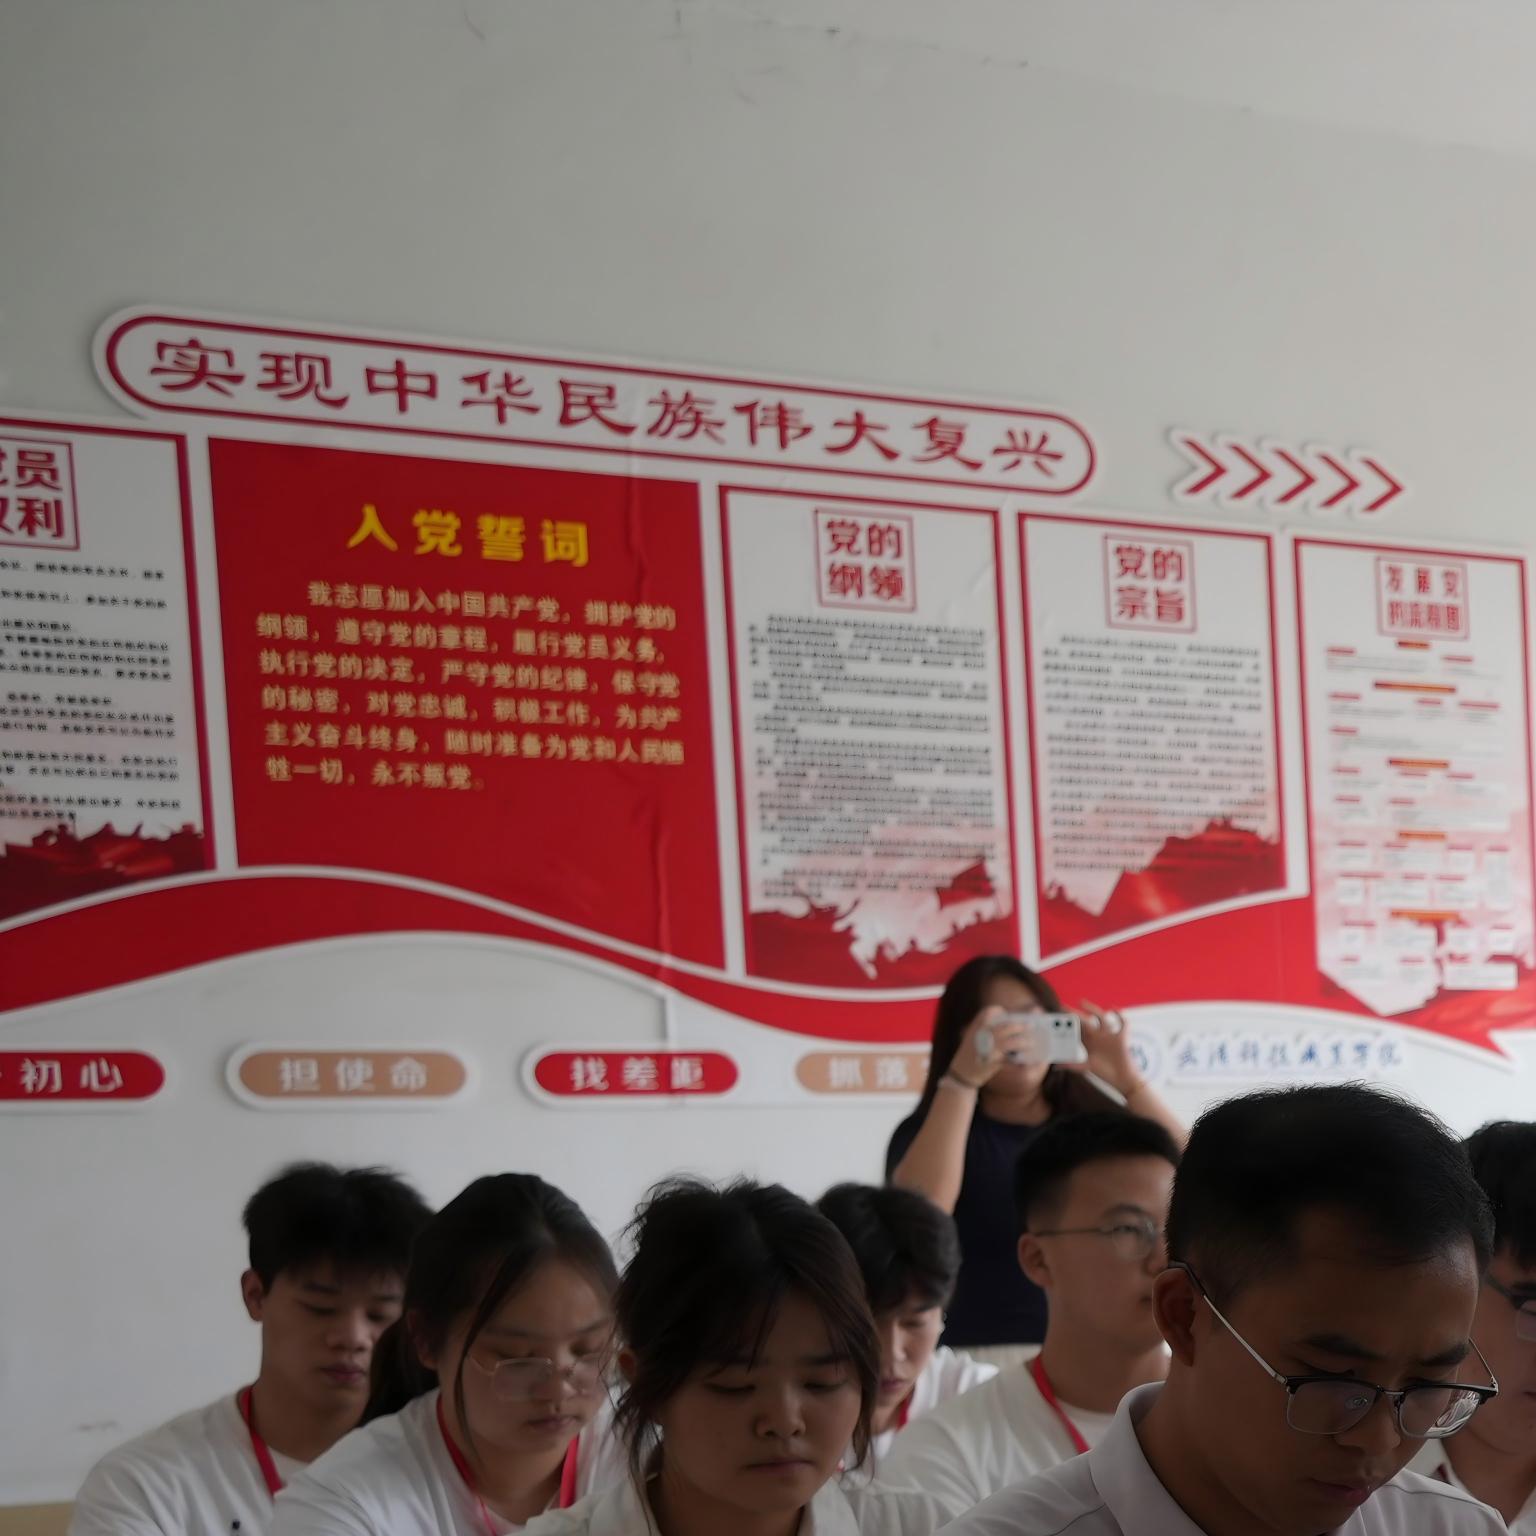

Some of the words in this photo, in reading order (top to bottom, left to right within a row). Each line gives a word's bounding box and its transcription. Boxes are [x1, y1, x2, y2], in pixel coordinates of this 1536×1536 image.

[150, 338, 1063, 478] 实现中华民族伟大复兴
[346, 503, 590, 568] 入党誓词
[826, 518, 902, 558] 党的
[828, 562, 903, 600] 纲领
[1115, 545, 1183, 581] 党的
[1117, 586, 1184, 622] 宗旨
[279, 1056, 429, 1091] 担使命
[570, 1056, 706, 1091] 找差距
[829, 1056, 928, 1088] 抓落
